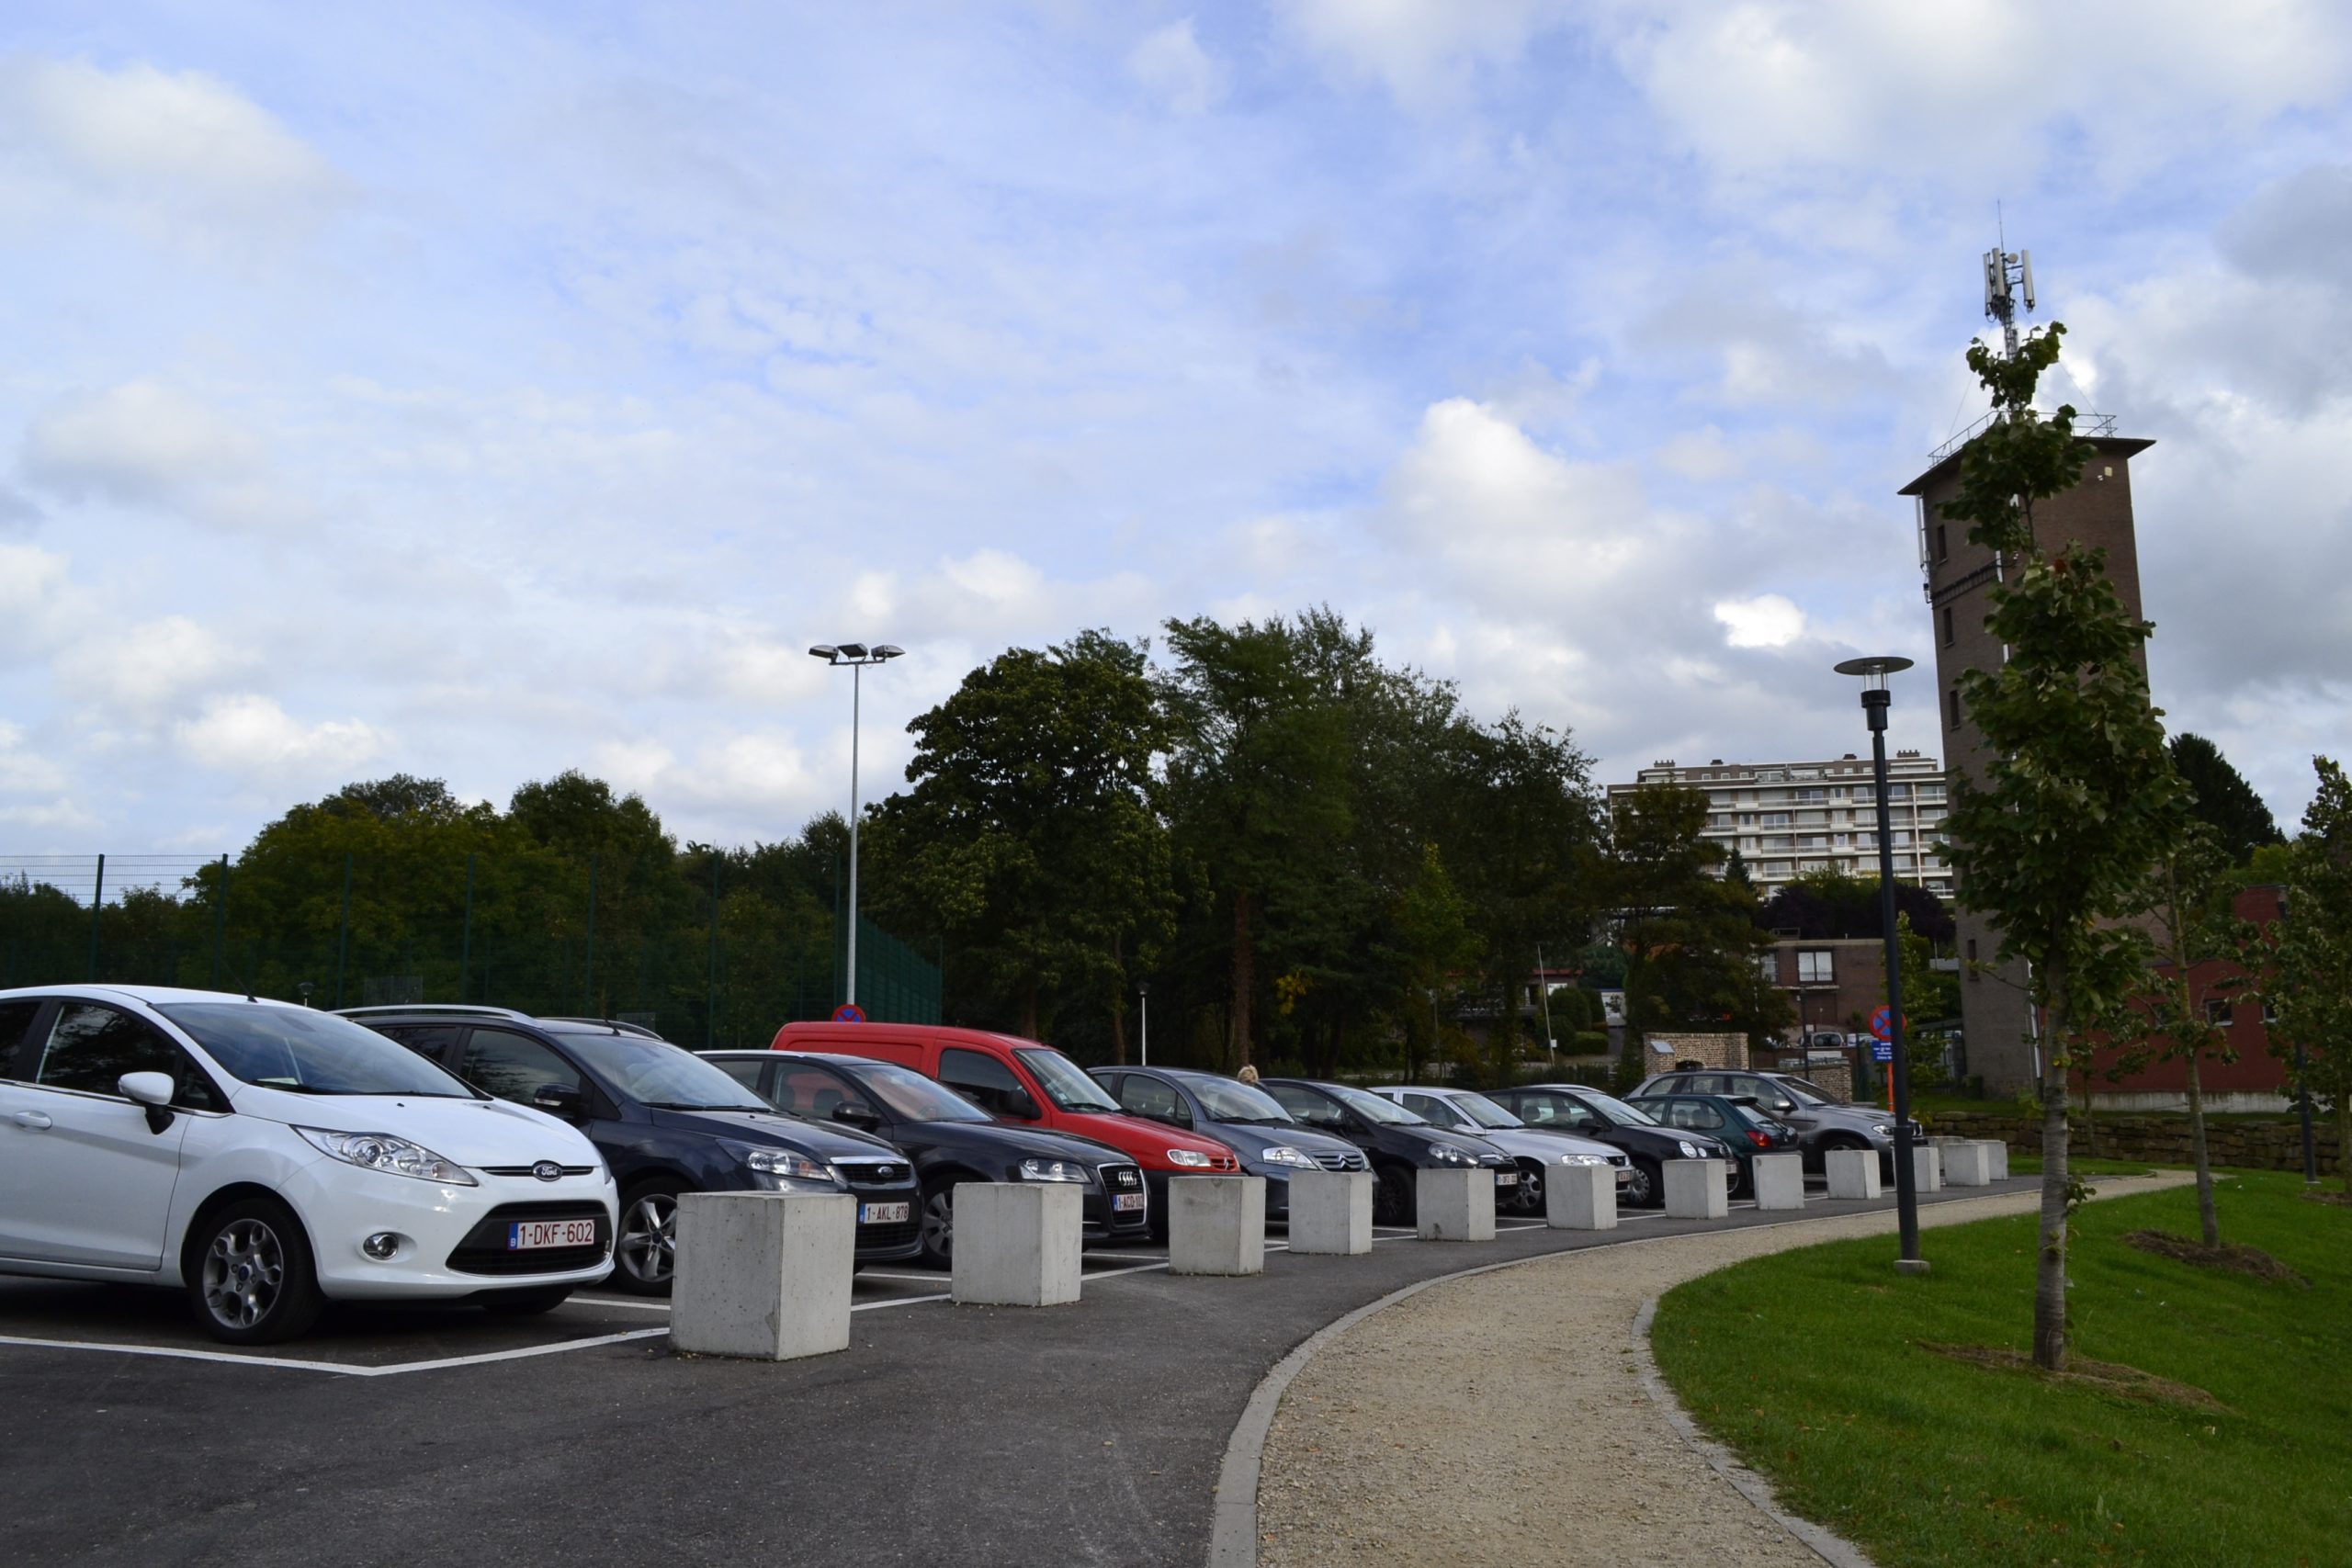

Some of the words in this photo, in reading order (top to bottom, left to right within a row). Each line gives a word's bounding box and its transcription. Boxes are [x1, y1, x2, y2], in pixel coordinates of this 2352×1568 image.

[540, 1166, 558, 1176] Ford
[867, 1205, 909, 1221] 1-AKL-878
[520, 1223, 593, 1246] 1-DKF-602
